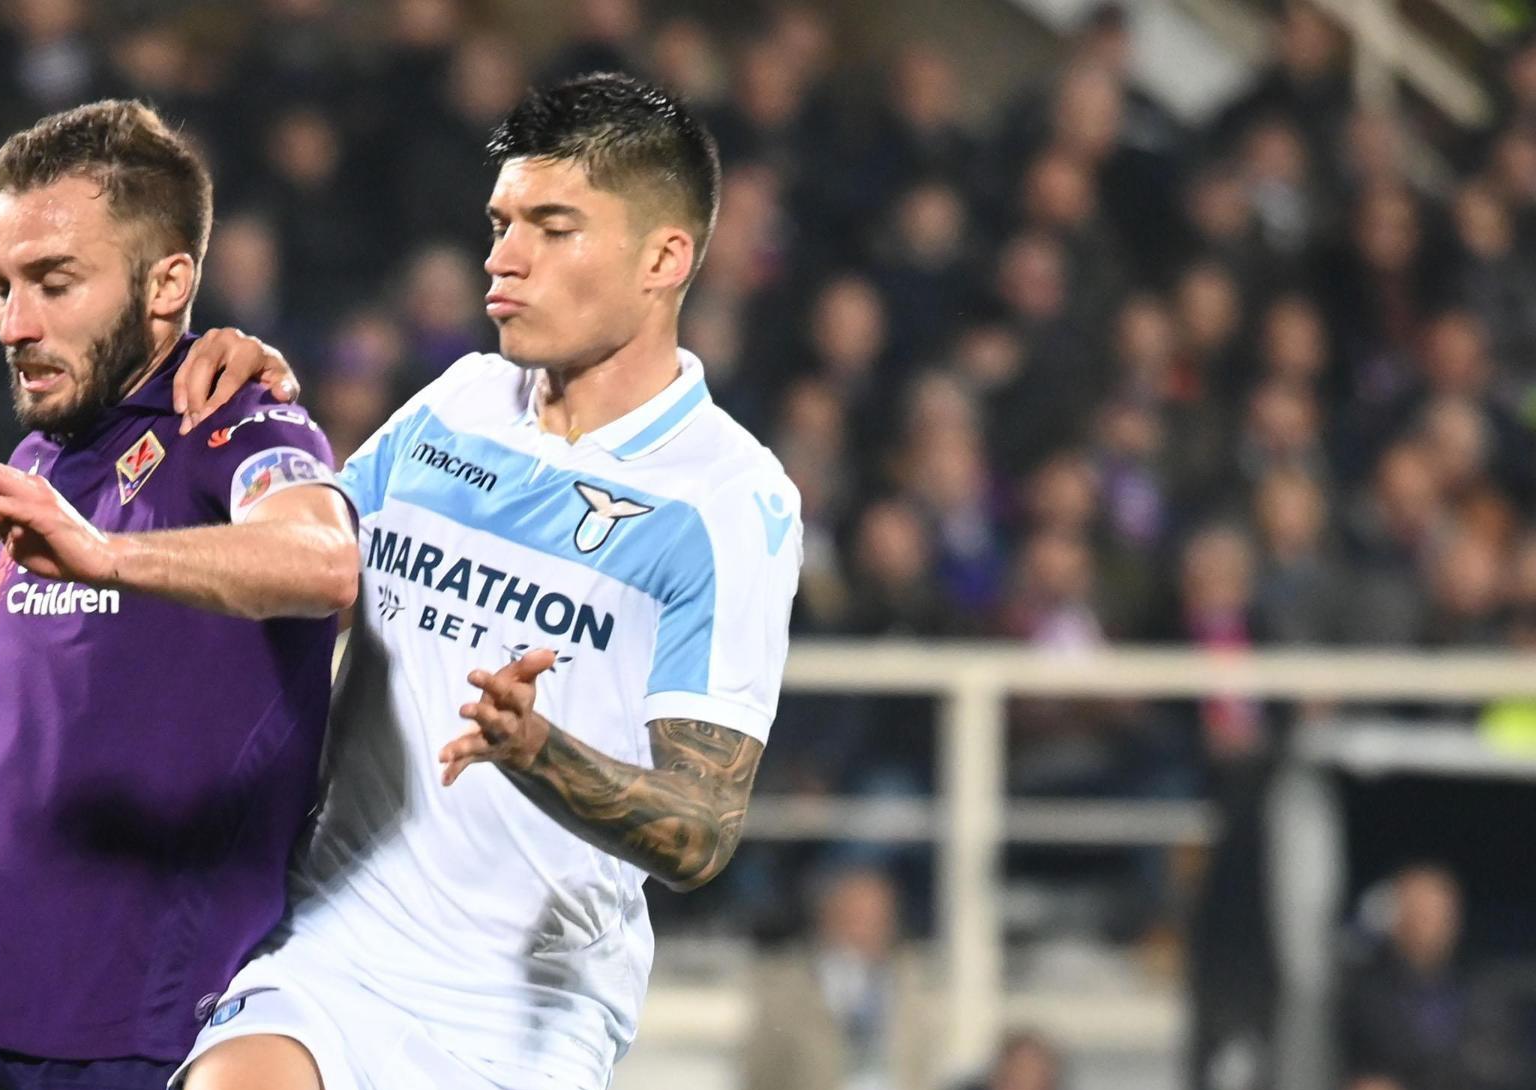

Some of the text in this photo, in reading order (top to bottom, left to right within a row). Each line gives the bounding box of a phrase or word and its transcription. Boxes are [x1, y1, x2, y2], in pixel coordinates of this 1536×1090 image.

[410, 443, 498, 493] macron
[6, 581, 120, 615] Children
[366, 527, 615, 652] MARATHON
[418, 605, 489, 648] BET
